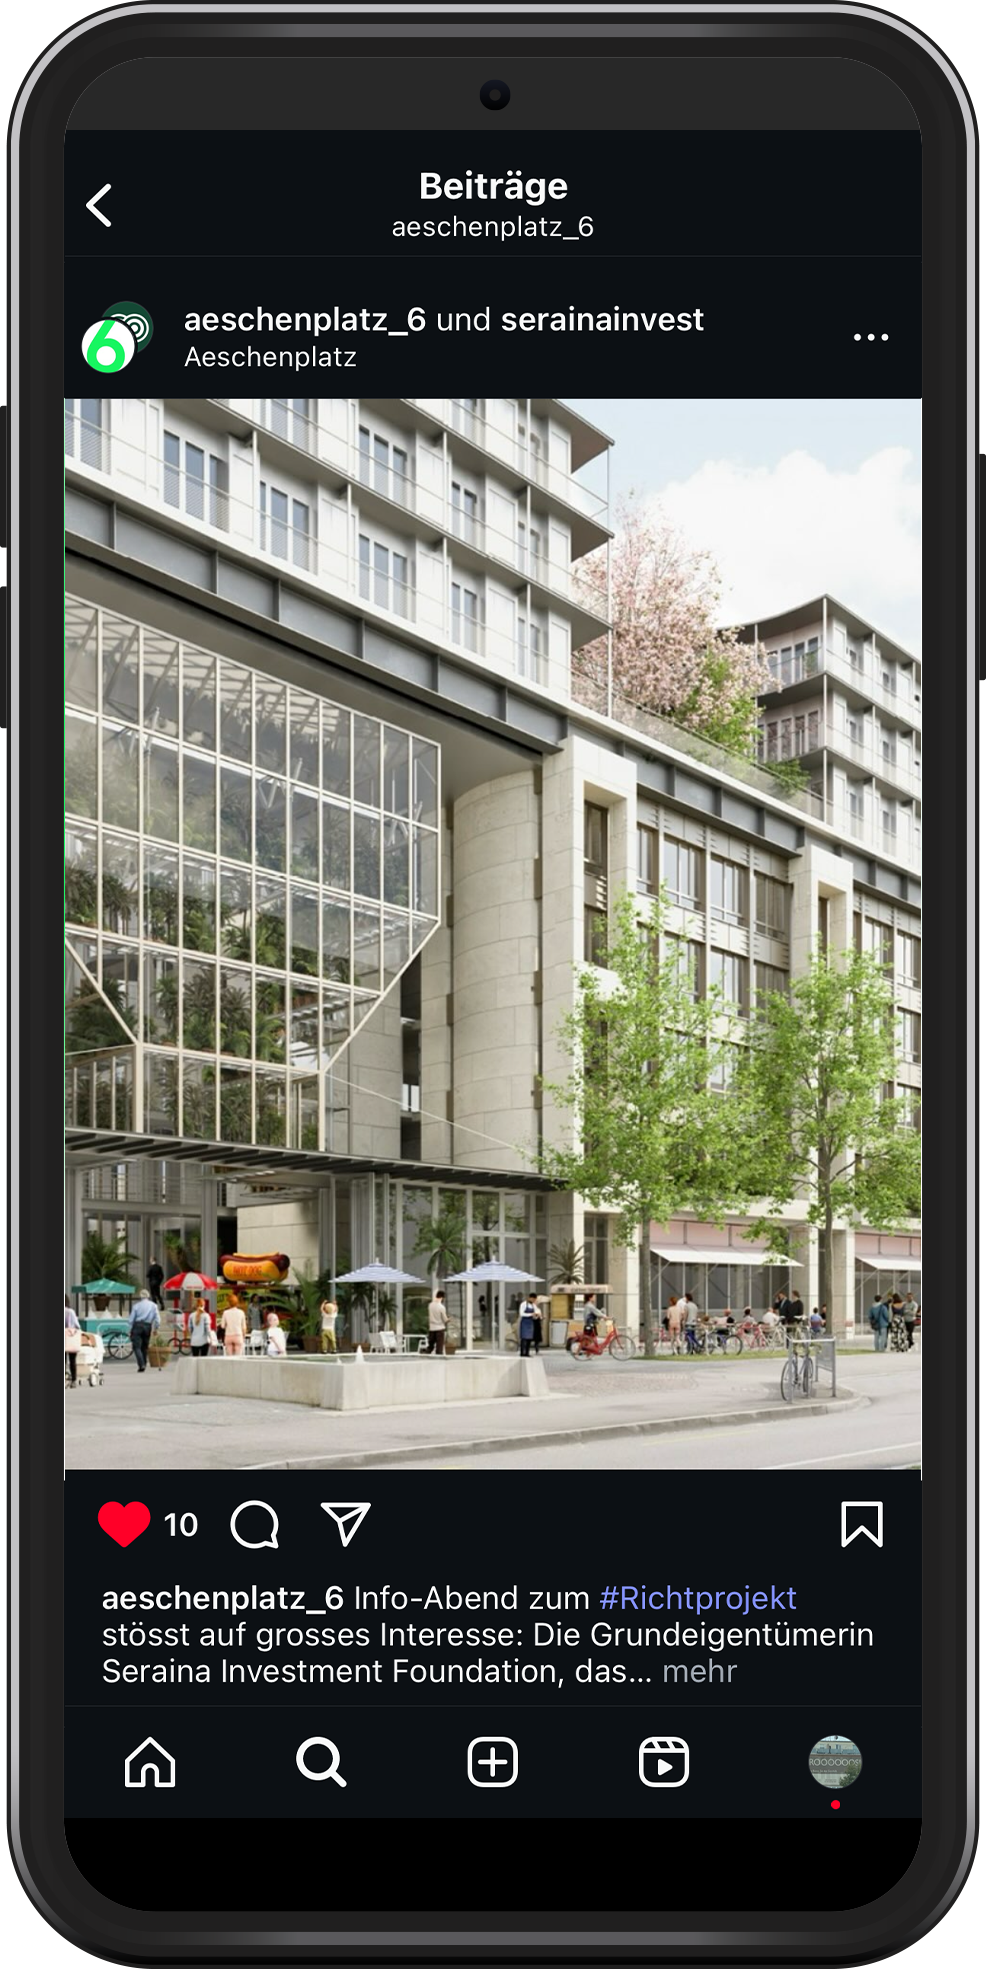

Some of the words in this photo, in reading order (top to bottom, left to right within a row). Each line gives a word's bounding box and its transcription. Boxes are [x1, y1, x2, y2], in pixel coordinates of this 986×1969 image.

[421, 170, 567, 206] Beiträge
[393, 215, 593, 241] aeschenplatz_6
[185, 306, 425, 336] aeschenplatz_6
[438, 307, 489, 331] und
[502, 306, 704, 331] serainainvest
[184, 346, 356, 371] Aeschenplatz
[165, 1512, 198, 1537] 10
[103, 1585, 343, 1615] aeschenplatz_6
[356, 1585, 517, 1610] Info-Abend
[530, 1591, 589, 1610] zum
[600, 1585, 796, 1615] #Richtprojekt
[103, 1622, 189, 1646] stösst
[200, 1622, 246, 1646] auf
[257, 1628, 369, 1652] grosses
[382, 1623, 522, 1646] Interesse:
[535, 1621, 580, 1646] Die
[591, 1621, 873, 1652] Grundeigentümerin
[103, 1658, 210, 1683] Seraina
[223, 1659, 382, 1683] Investment
[394, 1658, 563, 1688] Foundation,
[576, 1658, 651, 1683] das...
[664, 1658, 737, 1682] mehr
